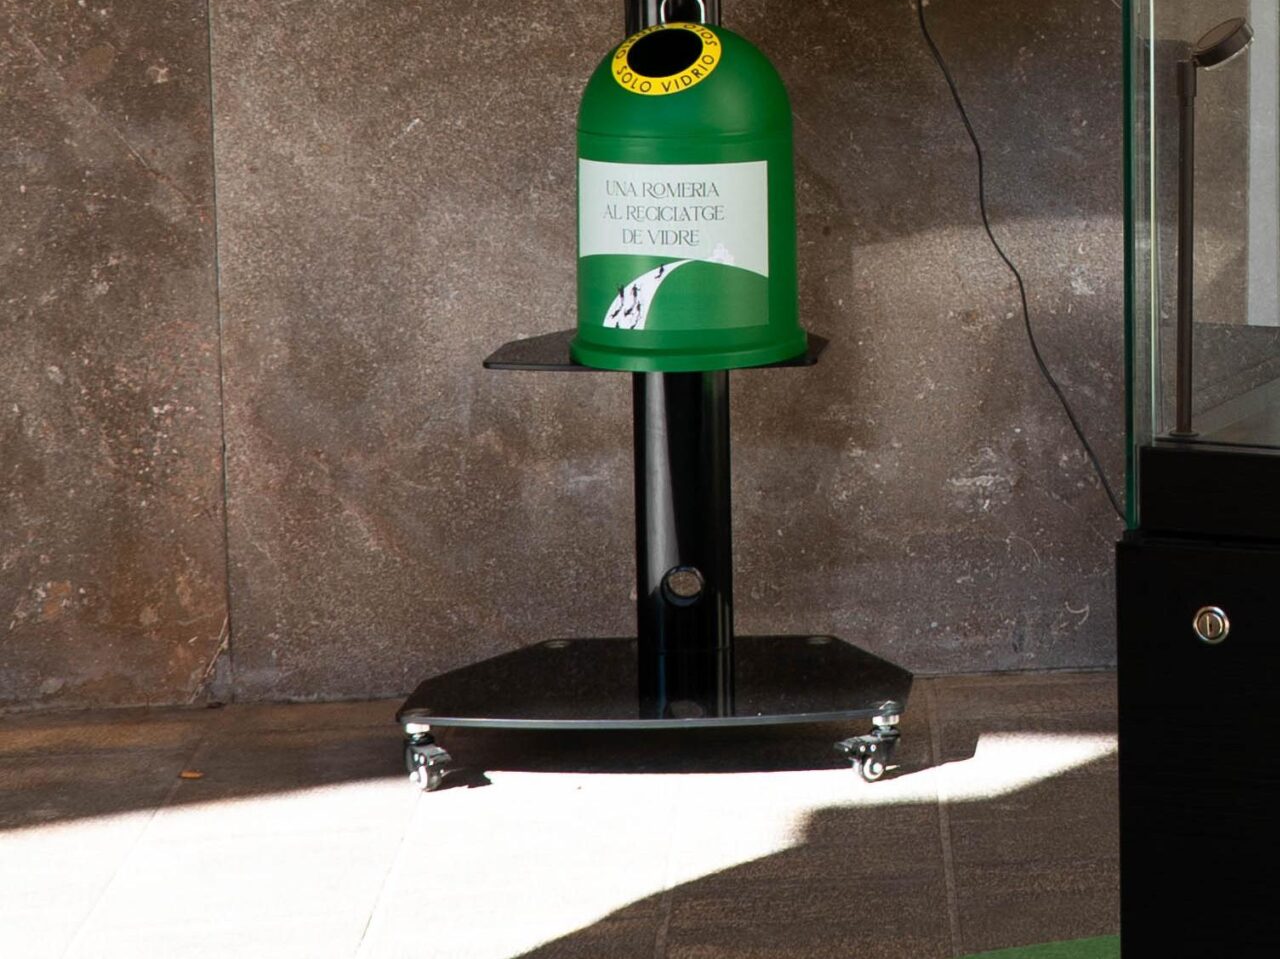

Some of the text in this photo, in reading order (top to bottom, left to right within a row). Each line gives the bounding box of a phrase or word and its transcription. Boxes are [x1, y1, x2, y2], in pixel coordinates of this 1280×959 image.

[616, 54, 715, 93] SOLO VIDRIO
[605, 179, 720, 199] UNA ROMERIA
[603, 203, 725, 223] AL RECICLATGE
[622, 227, 700, 247] DE VIDRE
